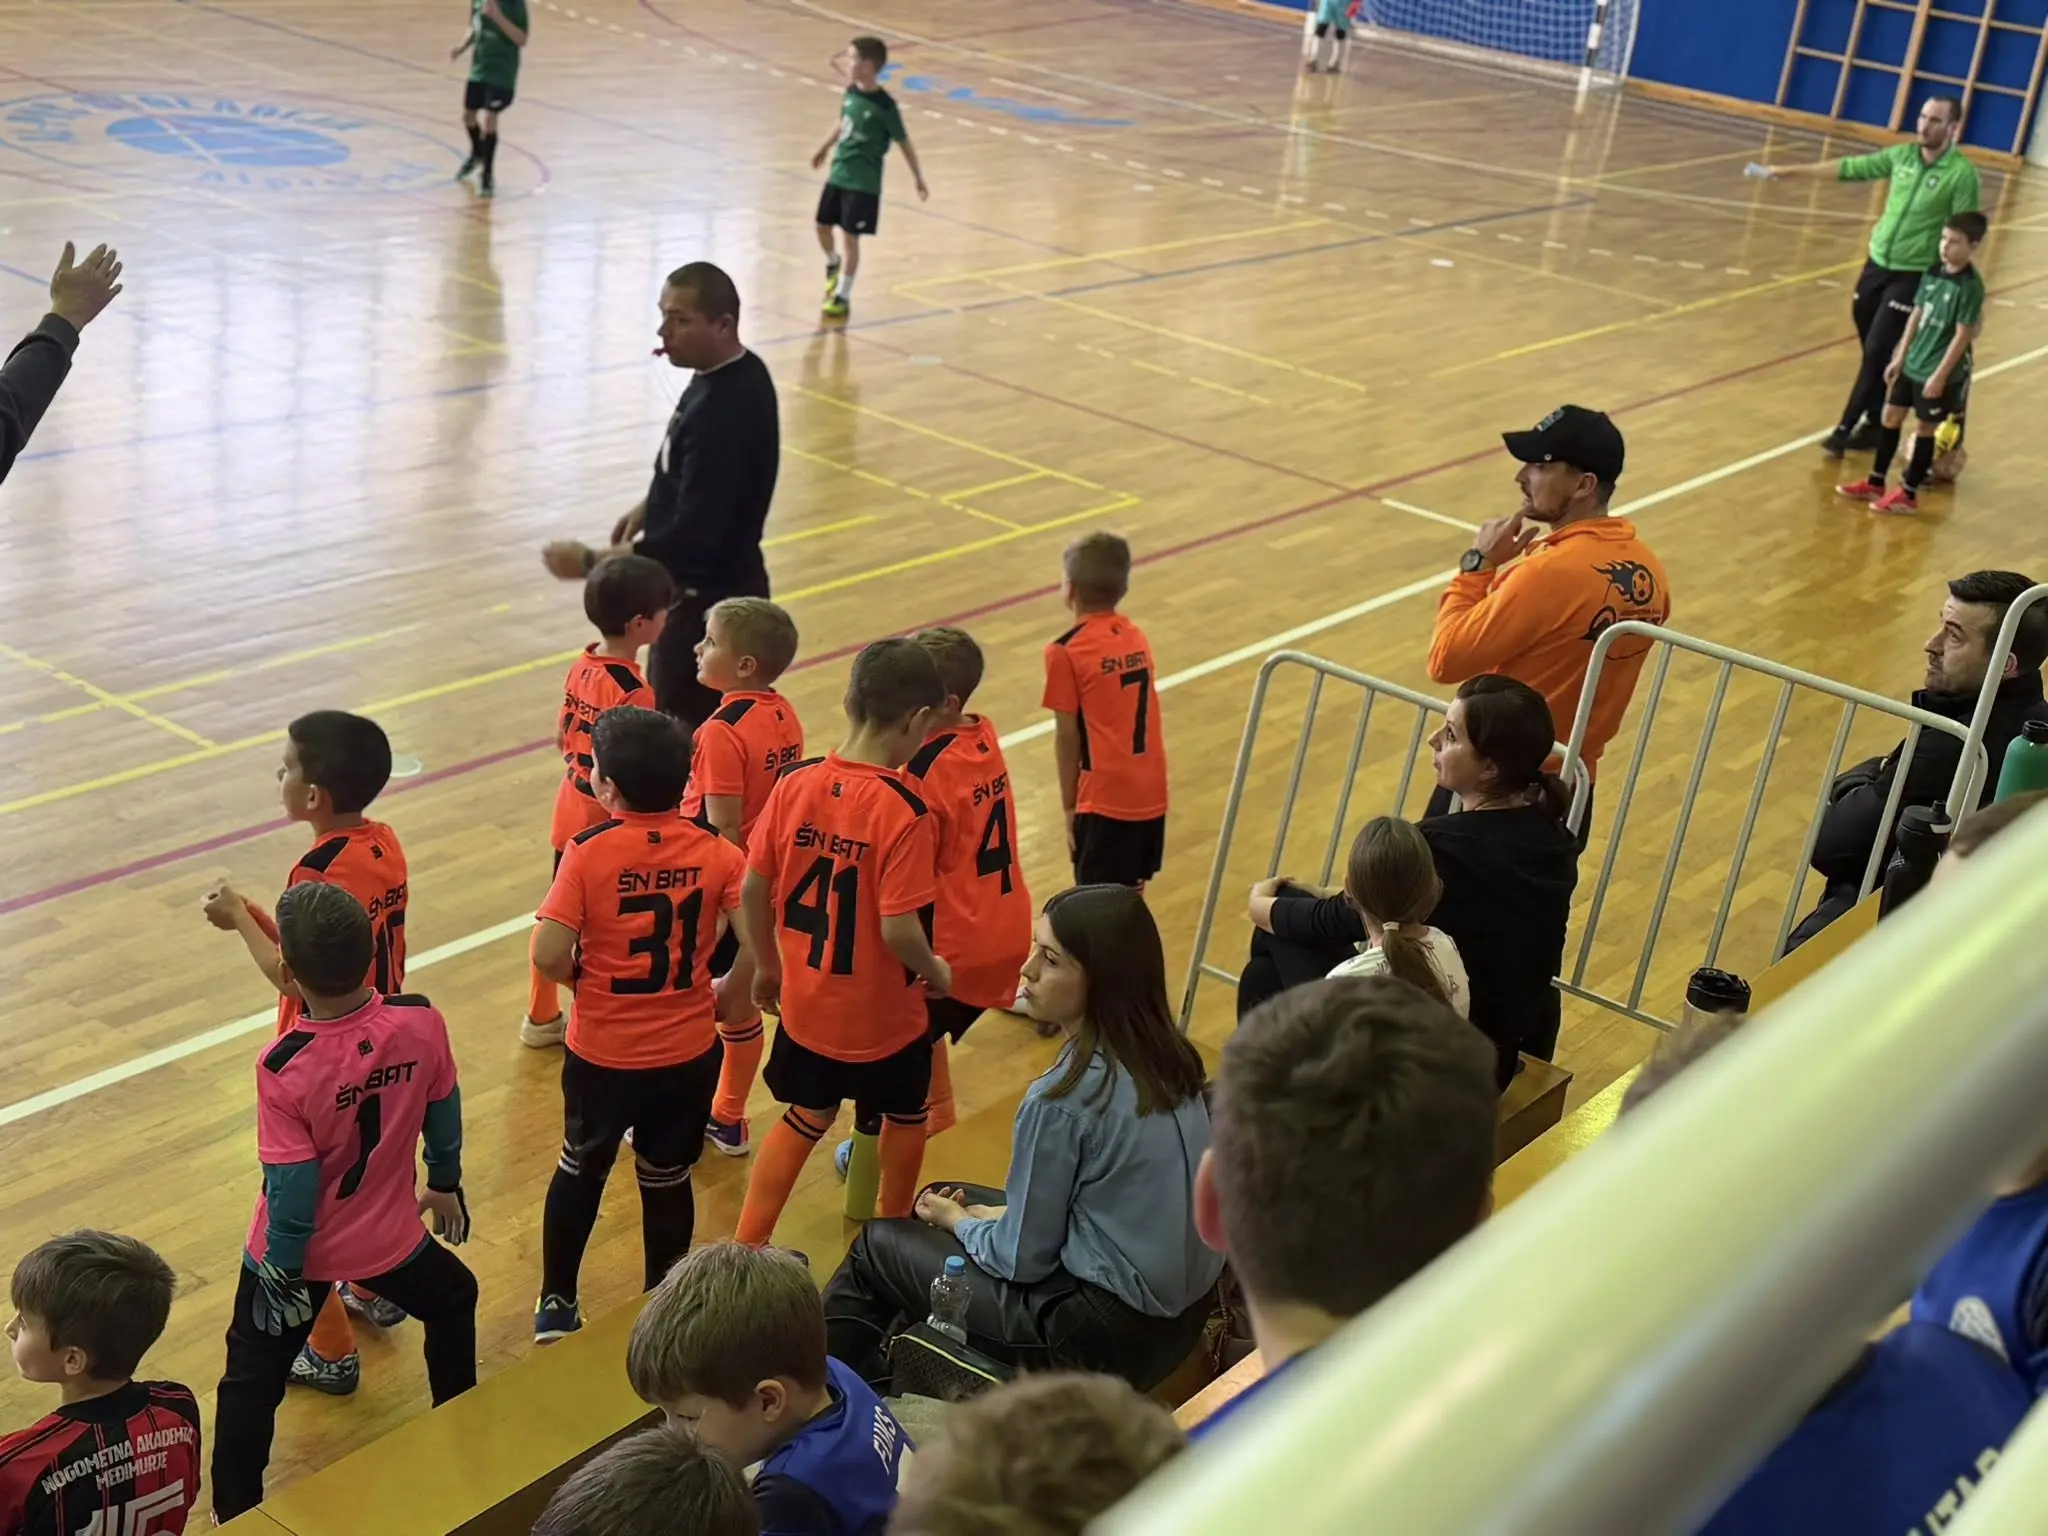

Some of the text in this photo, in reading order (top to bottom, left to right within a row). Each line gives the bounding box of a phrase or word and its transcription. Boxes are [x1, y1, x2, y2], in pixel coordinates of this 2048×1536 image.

[1119, 667, 1149, 755] 7
[617, 866, 703, 894] ŠN BAT
[794, 821, 827, 851] ŠN
[975, 796, 1013, 896] 4
[610, 887, 704, 995] 31
[783, 854, 859, 976] 41
[364, 1060, 418, 1091] BAT
[334, 1092, 382, 1201] 1
[40, 1439, 135, 1496] NOGOMETNA
